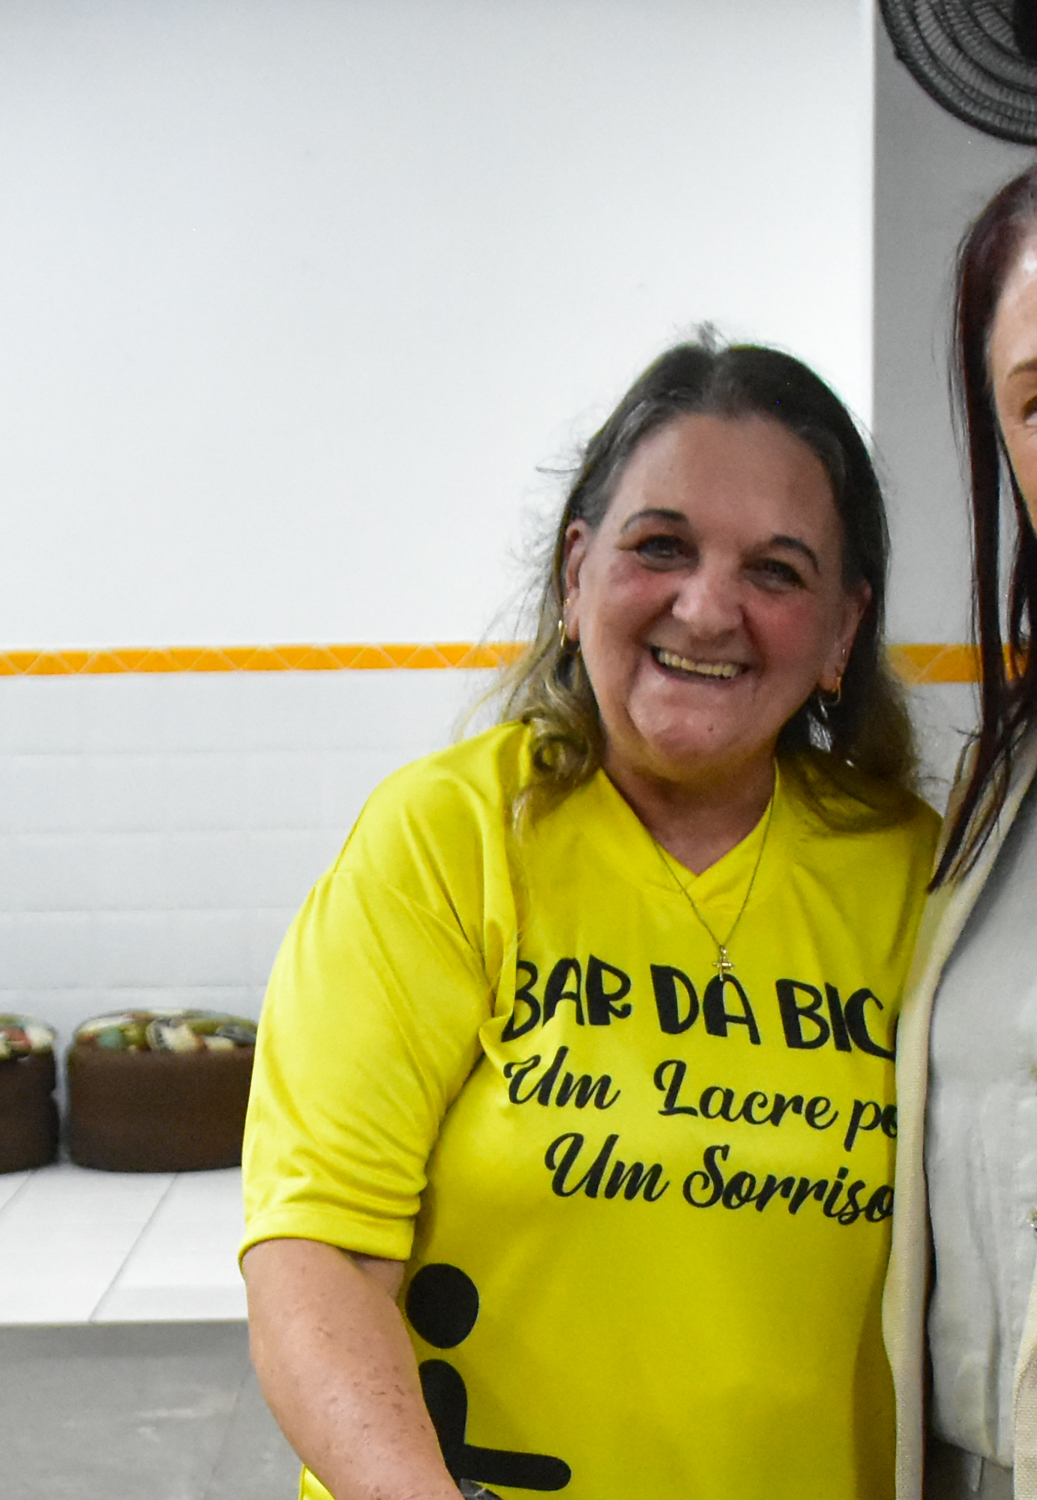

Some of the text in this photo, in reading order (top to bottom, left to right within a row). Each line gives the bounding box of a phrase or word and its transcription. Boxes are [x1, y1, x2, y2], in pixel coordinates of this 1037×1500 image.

[501, 953, 899, 1062] BAR DA BIC
[503, 1045, 898, 1152] Um Lacre po
[544, 1132, 895, 1226] Um Sorriso
